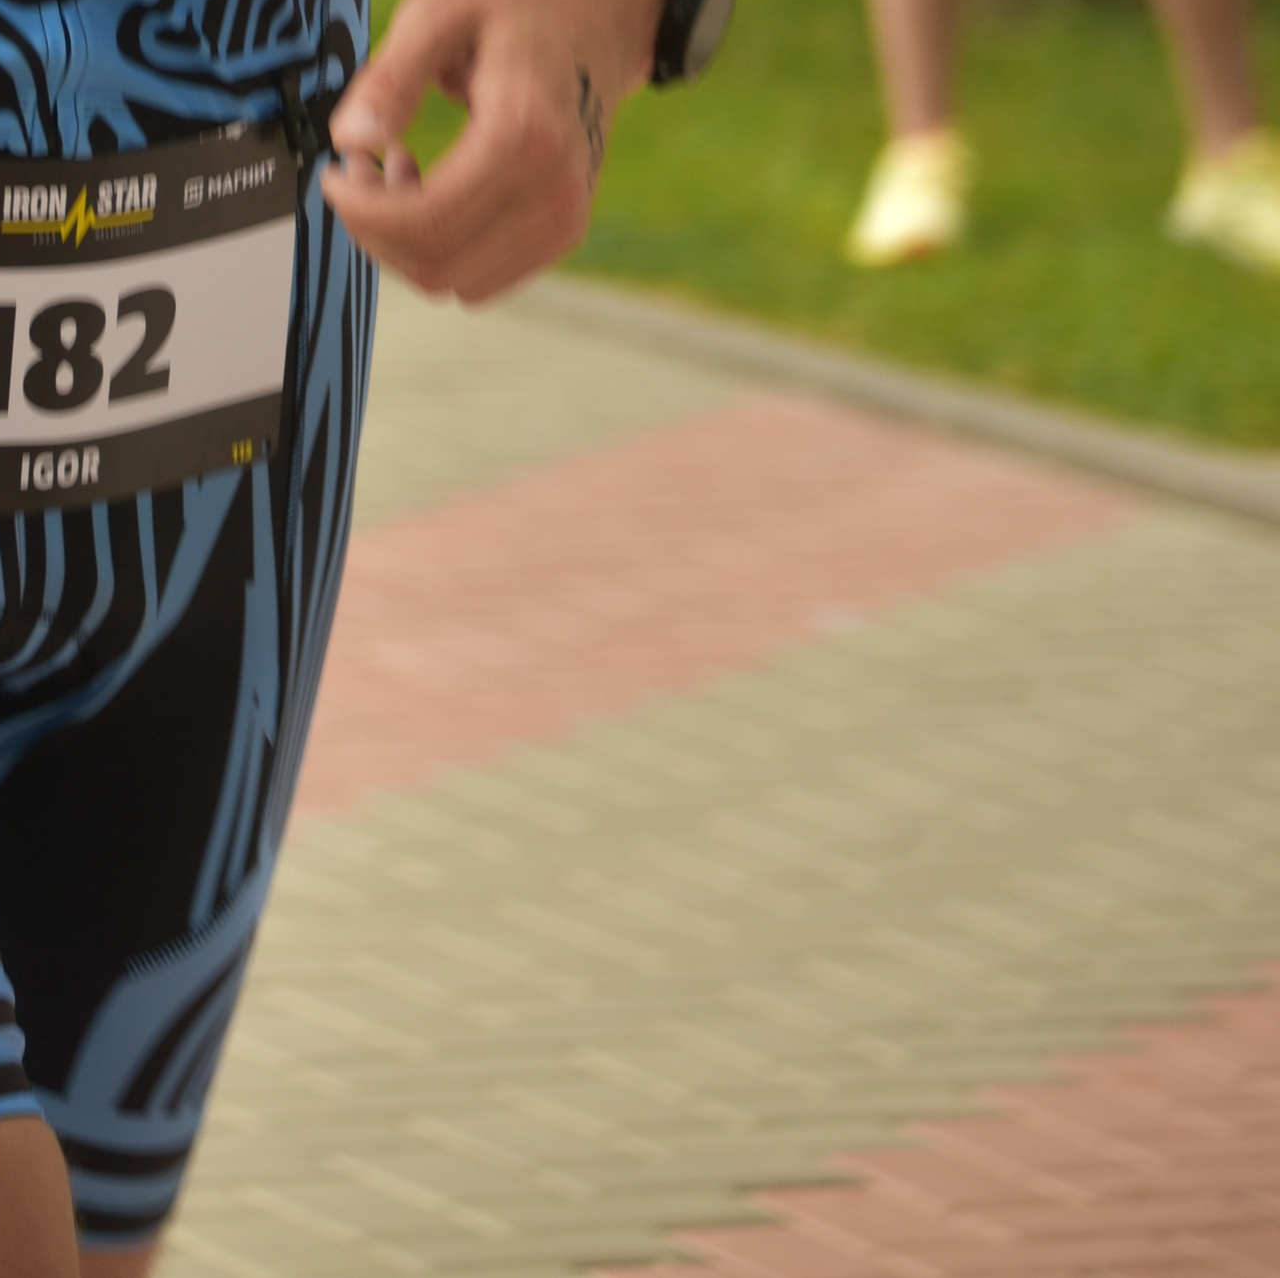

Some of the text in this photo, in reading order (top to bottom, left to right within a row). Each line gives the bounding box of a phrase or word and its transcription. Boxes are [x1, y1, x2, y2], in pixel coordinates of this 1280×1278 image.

[3, 174, 157, 222] IRON STAR
[208, 156, 276, 201] МАГНИТ
[20, 446, 100, 491] IGOR
